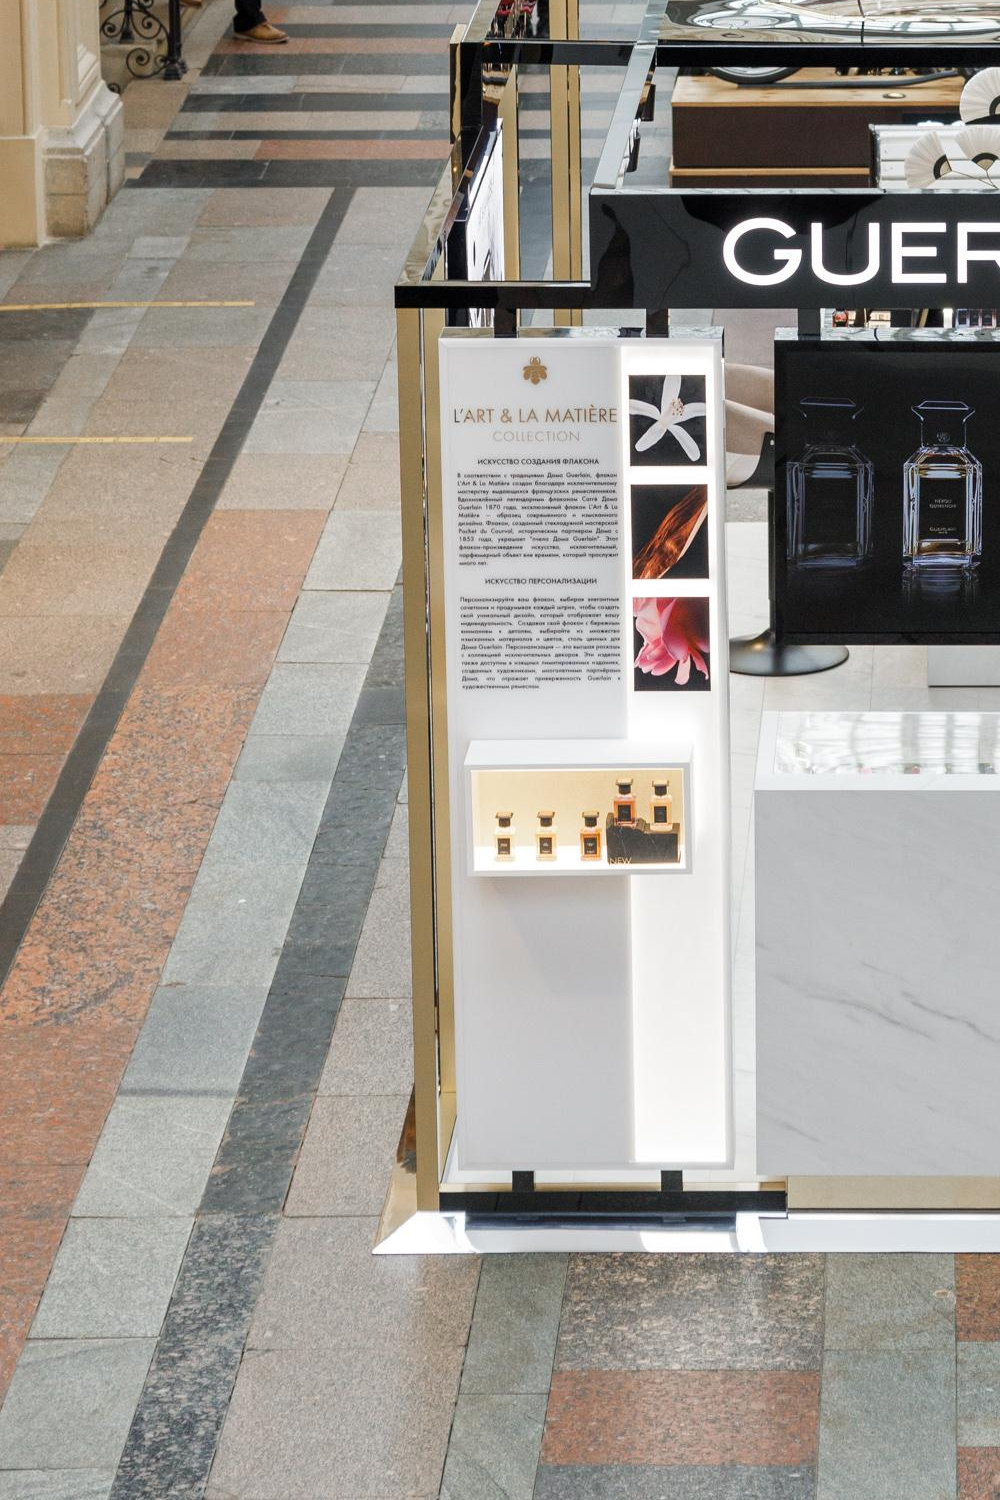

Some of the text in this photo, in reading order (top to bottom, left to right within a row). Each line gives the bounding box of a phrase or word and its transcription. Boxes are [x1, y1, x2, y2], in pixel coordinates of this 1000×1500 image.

[454, 404, 617, 423] L'ART & LA MATIÈRE
[493, 430, 580, 442] COLLECTION
[610, 856, 632, 864] NEW
